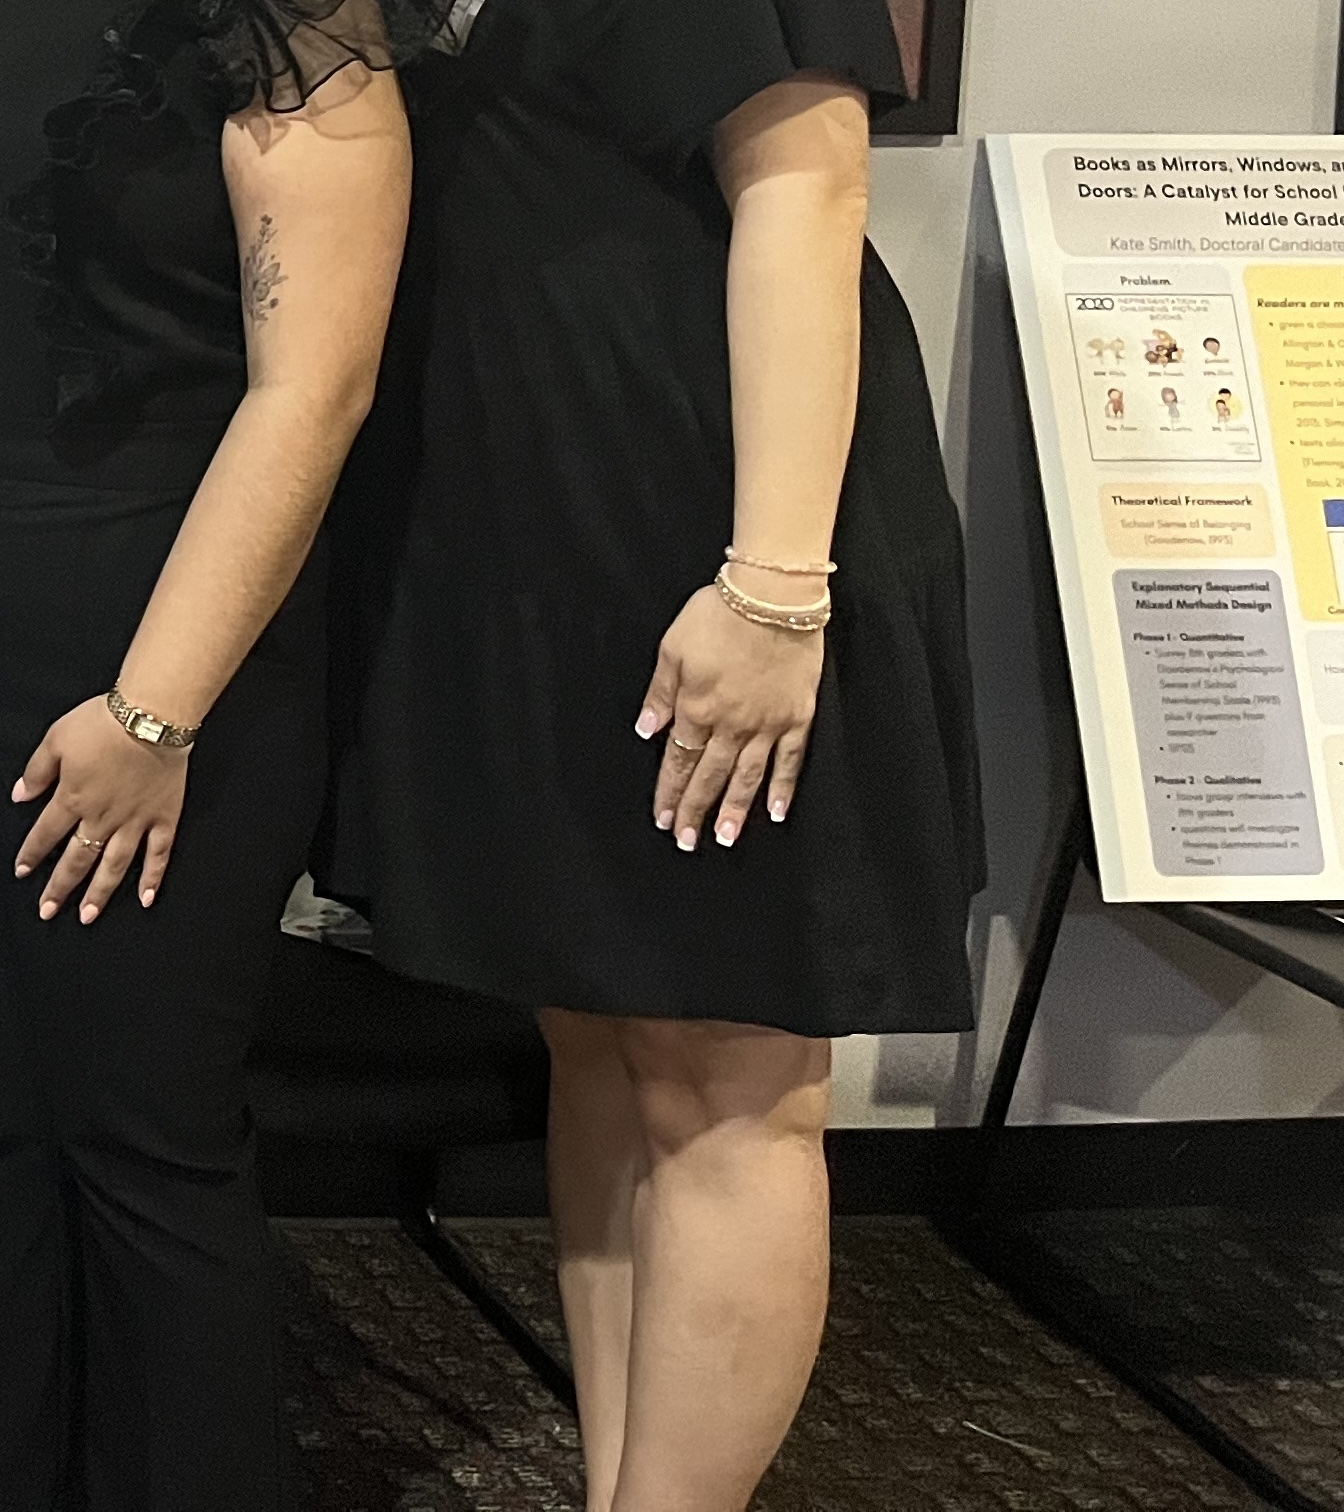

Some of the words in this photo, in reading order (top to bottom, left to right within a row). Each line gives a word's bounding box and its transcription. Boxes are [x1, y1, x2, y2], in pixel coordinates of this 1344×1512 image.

[1072, 156, 1130, 171] Books
[1136, 160, 1156, 171] as
[1160, 155, 1233, 173] Mirrors,
[1236, 156, 1326, 173] Windows,
[1077, 184, 1138, 199] Doors:
[1143, 184, 1157, 198] A
[1161, 183, 1238, 202] Catalyst
[1243, 184, 1268, 199] for
[1273, 184, 1337, 199] School
[1224, 211, 1288, 226] Middle
[1110, 238, 1144, 251] Kate
[1148, 237, 1195, 251] Smith,
[1199, 236, 1264, 252] Doctoral
[1119, 275, 1171, 285] Problem
[1075, 297, 1114, 311] 2020
[1256, 297, 1306, 308] Readers
[1110, 495, 1182, 506] Theoretical
[1184, 495, 1253, 506] Framework
[1130, 581, 1203, 595] Explanatory
[1204, 581, 1270, 594] Sequential
[1135, 599, 1173, 610] Mixed
[1175, 599, 1229, 610] Methods
[1230, 599, 1272, 613] Design
